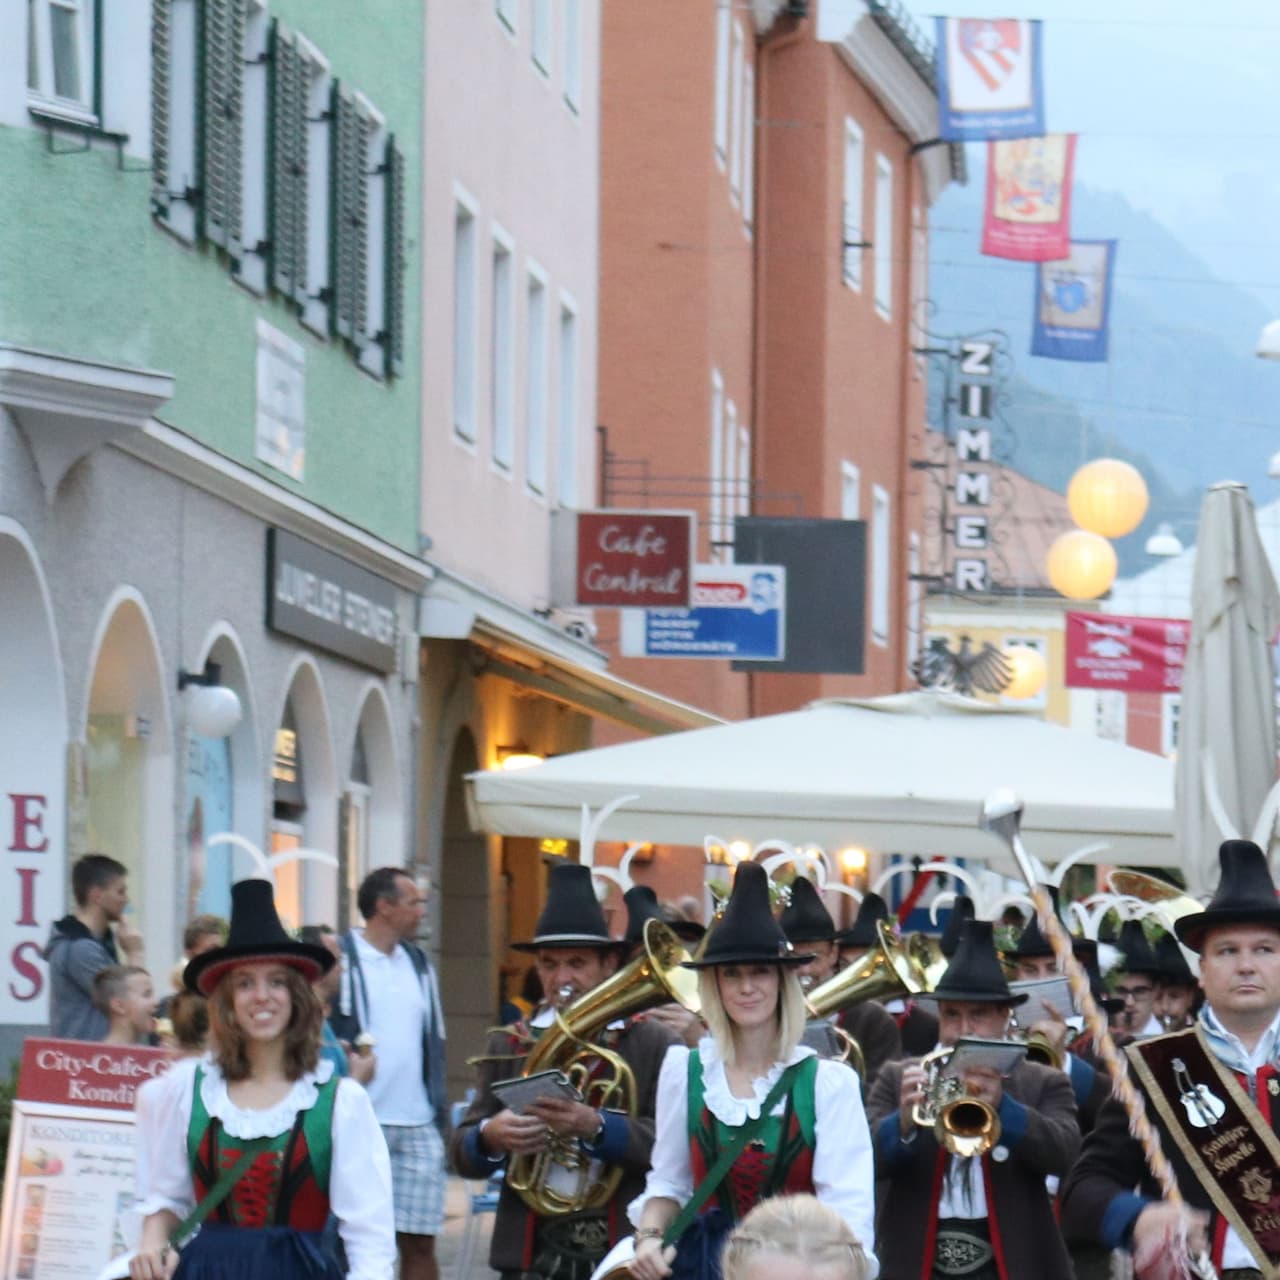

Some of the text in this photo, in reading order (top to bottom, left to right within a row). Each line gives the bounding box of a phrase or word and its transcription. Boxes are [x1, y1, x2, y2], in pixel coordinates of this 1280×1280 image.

[956, 342, 992, 591] ZIMMER
[600, 526, 666, 556] Cafe
[275, 562, 341, 625] JUWELIER
[584, 565, 682, 595] Central
[7, 793, 49, 1001] EIS
